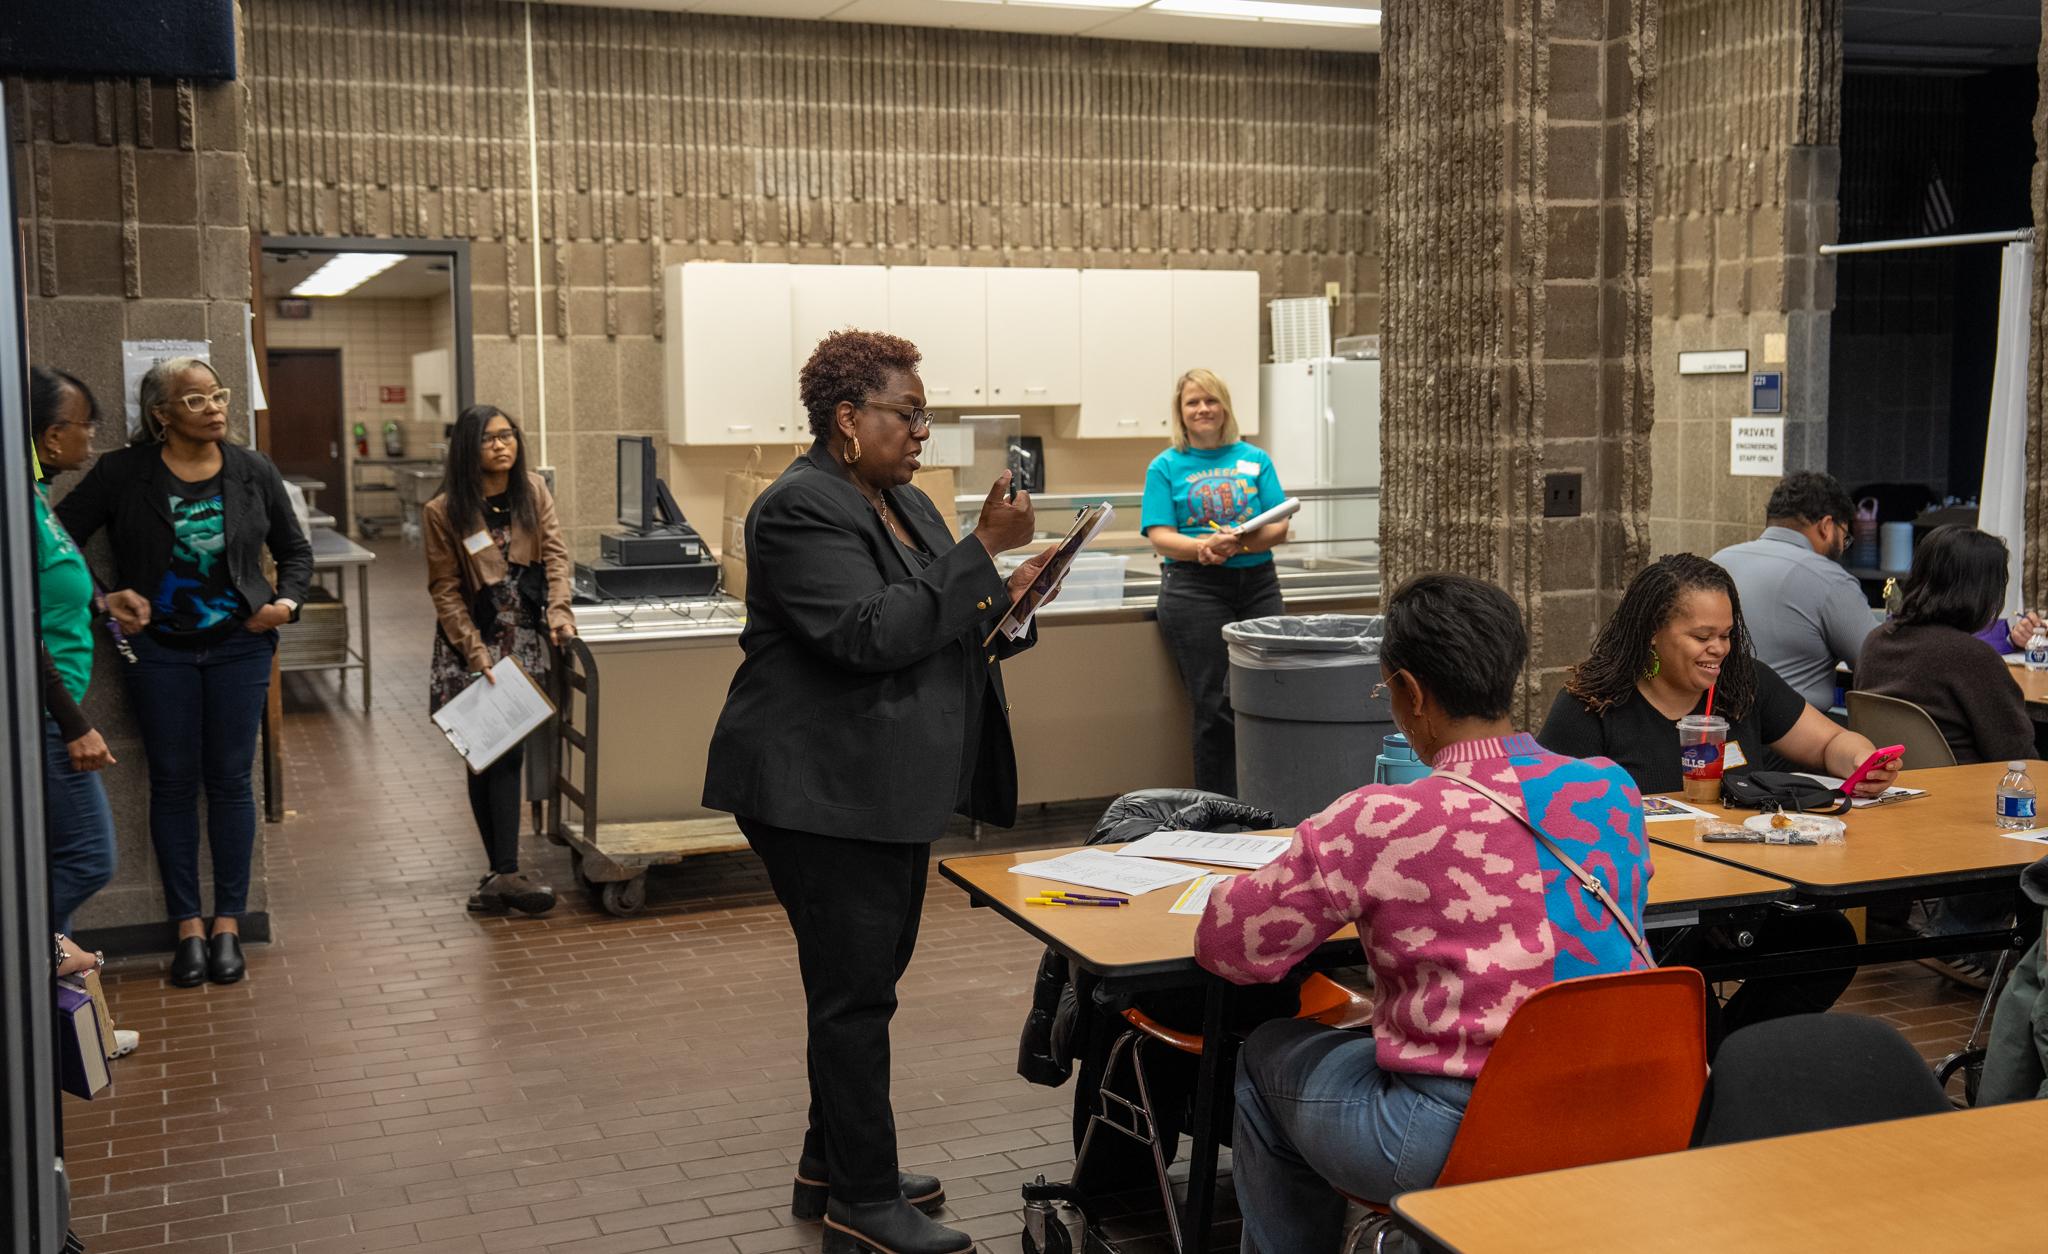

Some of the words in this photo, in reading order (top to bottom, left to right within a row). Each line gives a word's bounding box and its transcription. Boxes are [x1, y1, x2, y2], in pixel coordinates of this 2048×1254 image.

[1754, 376, 1766, 386] 221
[1738, 428, 1775, 438] PRIVATE
[1736, 443, 1778, 451] ENGINEERING
[1739, 454, 1756, 462] STAFF
[1757, 454, 1774, 463] ONLY
[1681, 757, 1706, 769] BILLS
